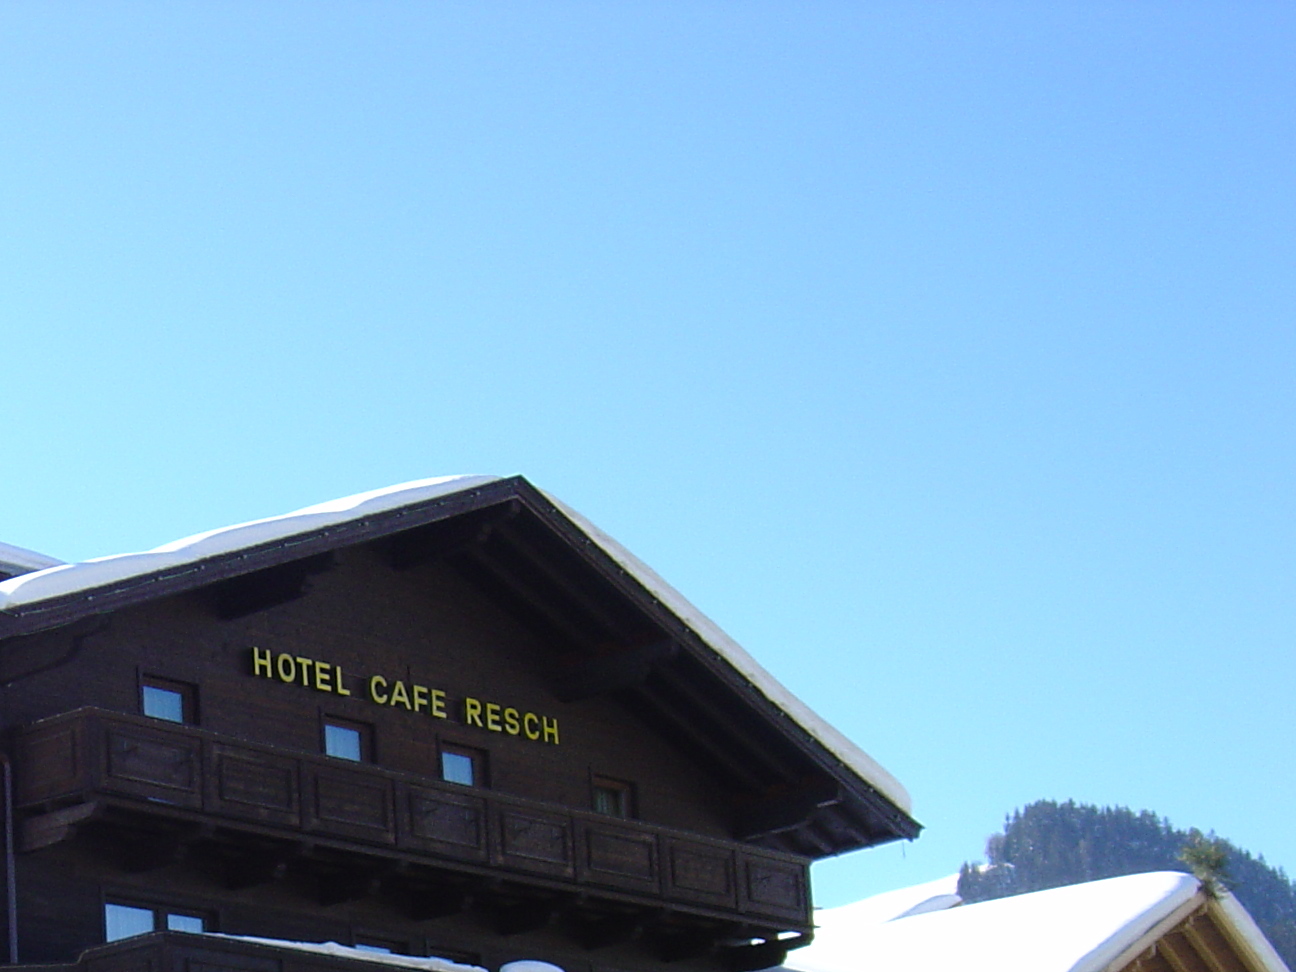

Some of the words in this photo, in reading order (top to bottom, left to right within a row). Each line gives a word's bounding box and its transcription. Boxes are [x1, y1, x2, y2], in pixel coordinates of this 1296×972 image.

[253, 646, 351, 696] HOTEL
[370, 674, 448, 719] CAFE
[466, 697, 560, 744] RESCH
